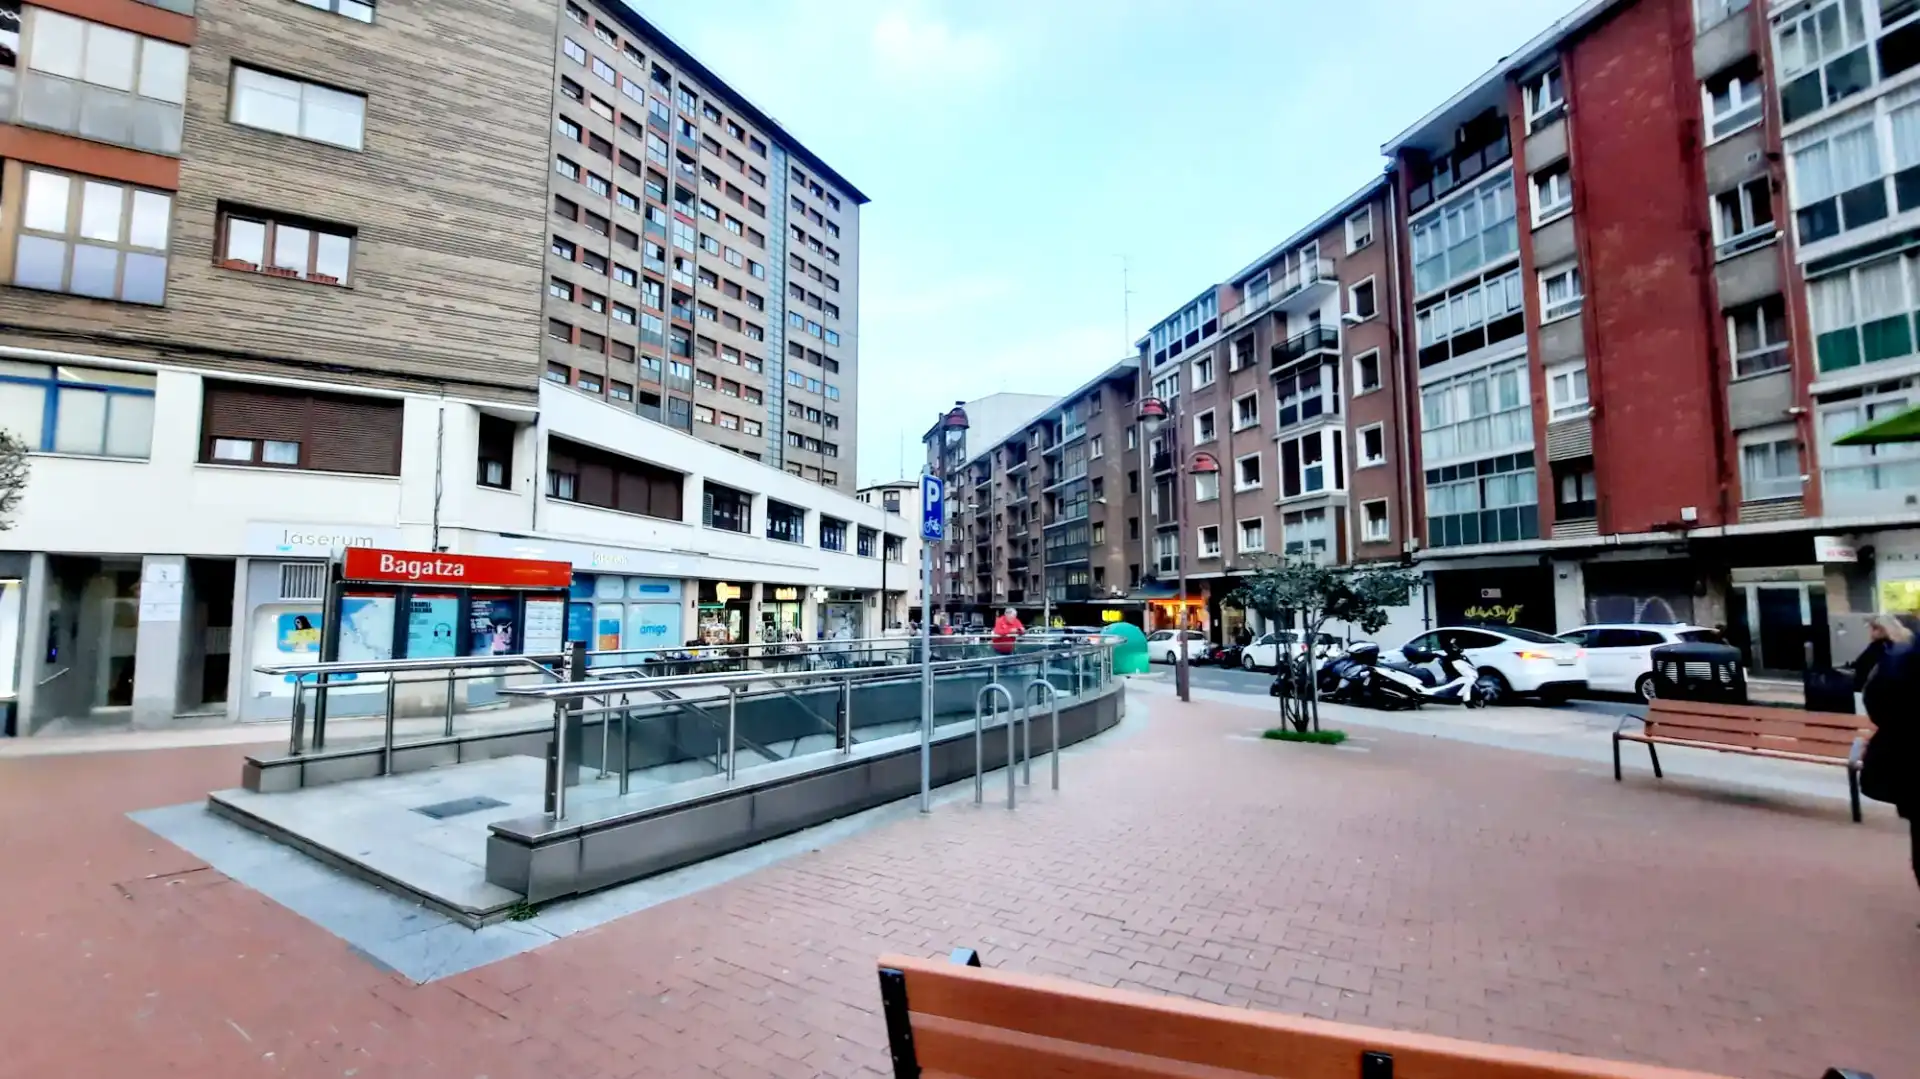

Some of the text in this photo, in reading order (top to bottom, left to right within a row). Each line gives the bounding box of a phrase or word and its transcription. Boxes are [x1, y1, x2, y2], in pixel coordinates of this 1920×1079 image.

[926, 480, 940, 512] P
[284, 529, 374, 548] laserum
[380, 553, 465, 579] Bagatza
[640, 624, 668, 637] amigo
